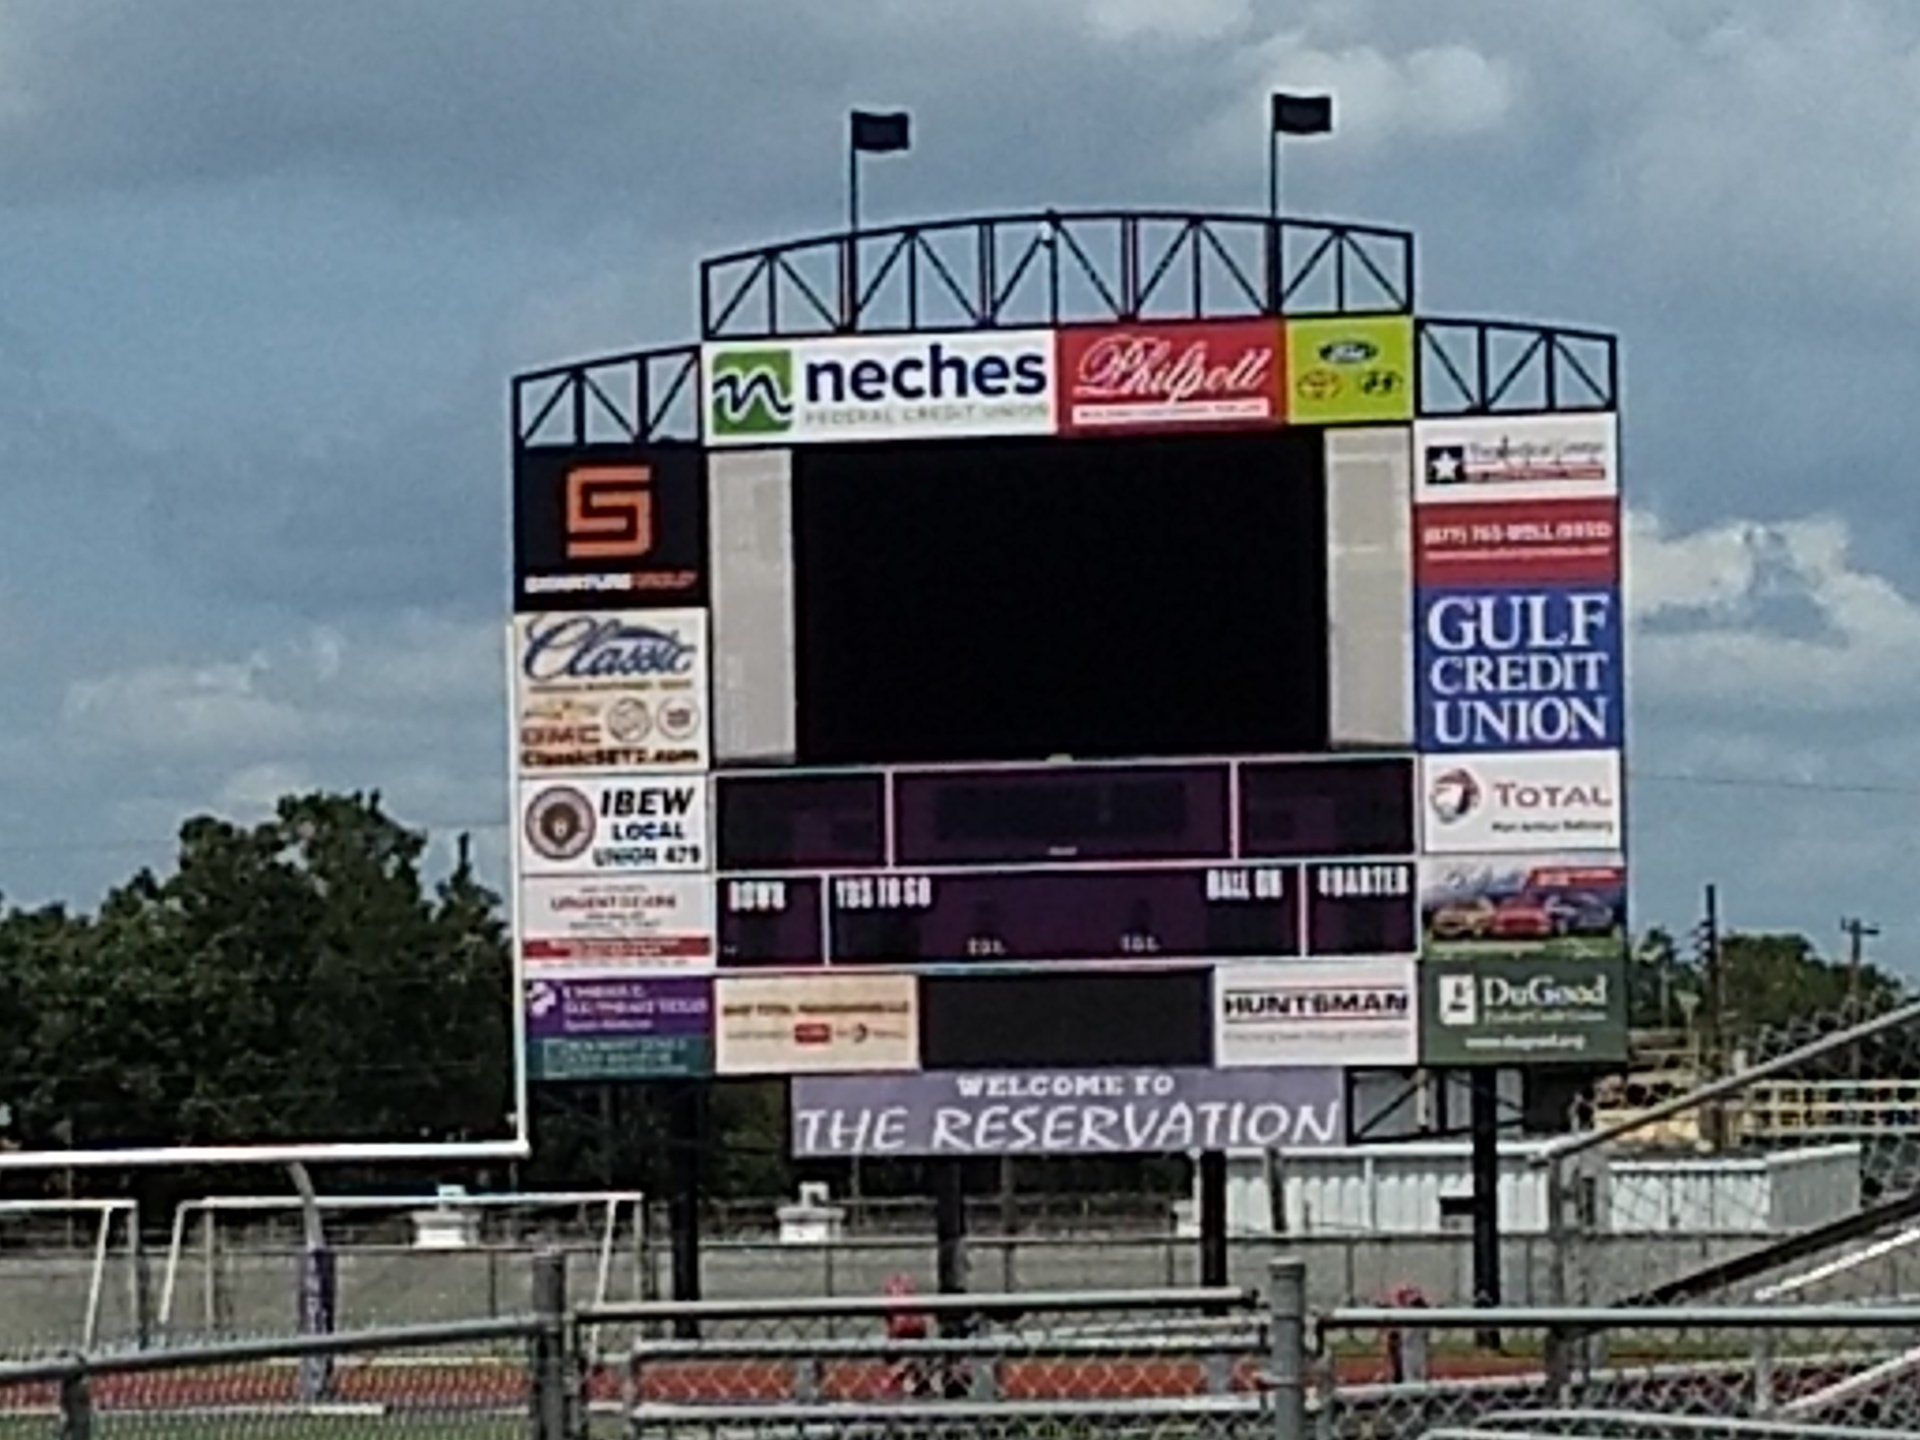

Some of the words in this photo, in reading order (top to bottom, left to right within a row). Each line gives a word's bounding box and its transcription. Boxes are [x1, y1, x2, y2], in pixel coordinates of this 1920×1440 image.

[805, 342, 1048, 403] neches
[1427, 591, 1610, 652] GULF
[524, 612, 698, 682] Classic
[1429, 651, 1610, 696] CREDIT
[1432, 695, 1611, 744] UNION
[600, 786, 697, 818] IBEW
[1491, 782, 1614, 809] TOTAL
[611, 821, 685, 843] LOCAL
[592, 846, 658, 868] UNION
[1318, 864, 1409, 896] QUARTER
[1224, 992, 1408, 1015] HUNTSMAN
[1482, 973, 1607, 1008] DuGood
[956, 1074, 1125, 1097] WELCOME
[1134, 1073, 1176, 1096] TO
[797, 1105, 910, 1154] THE
[931, 1099, 1342, 1151] RESERVATION
